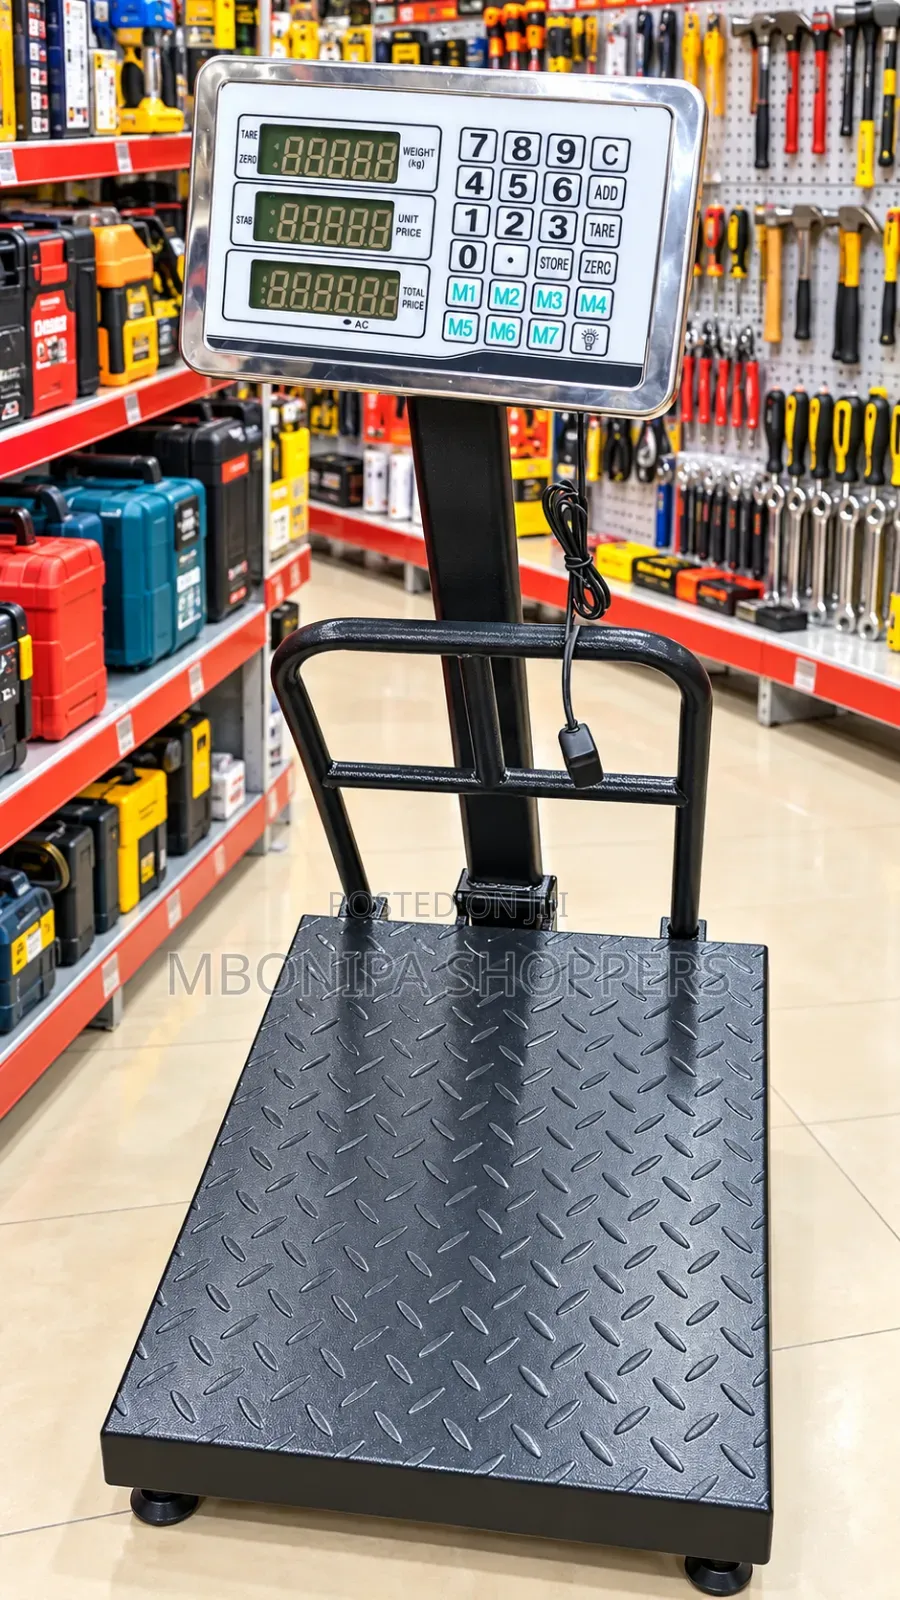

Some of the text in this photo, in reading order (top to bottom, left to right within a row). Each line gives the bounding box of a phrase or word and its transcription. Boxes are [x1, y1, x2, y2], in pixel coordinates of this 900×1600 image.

[241, 129, 258, 140] TARE
[403, 146, 435, 158] WEIGHT
[469, 132, 488, 158] 7
[511, 136, 532, 161] 8
[556, 139, 576, 164] 9
[602, 144, 619, 166] C
[239, 154, 257, 165] ZERO
[408, 158, 425, 170] (kg)
[465, 171, 484, 195] 4
[508, 173, 528, 199] 5
[552, 177, 573, 202] 6
[594, 185, 618, 201] ADD
[236, 215, 253, 226] STAB
[398, 214, 419, 225] UNIT
[464, 208, 478, 232] 1
[504, 211, 525, 236] 2
[548, 215, 568, 240] 3
[396, 227, 422, 239] PRICE
[589, 222, 616, 239] TARE
[459, 244, 478, 269] 0
[539, 256, 570, 273] STORE
[403, 286, 425, 298] TOTAL
[452, 282, 477, 302] M1
[494, 286, 521, 307] M2
[536, 289, 564, 309] M3
[402, 299, 424, 311] PRICE
[580, 293, 608, 314] M4
[355, 320, 369, 330] AC
[448, 317, 473, 337] M5
[490, 321, 517, 342] M6
[532, 325, 560, 345] M7
